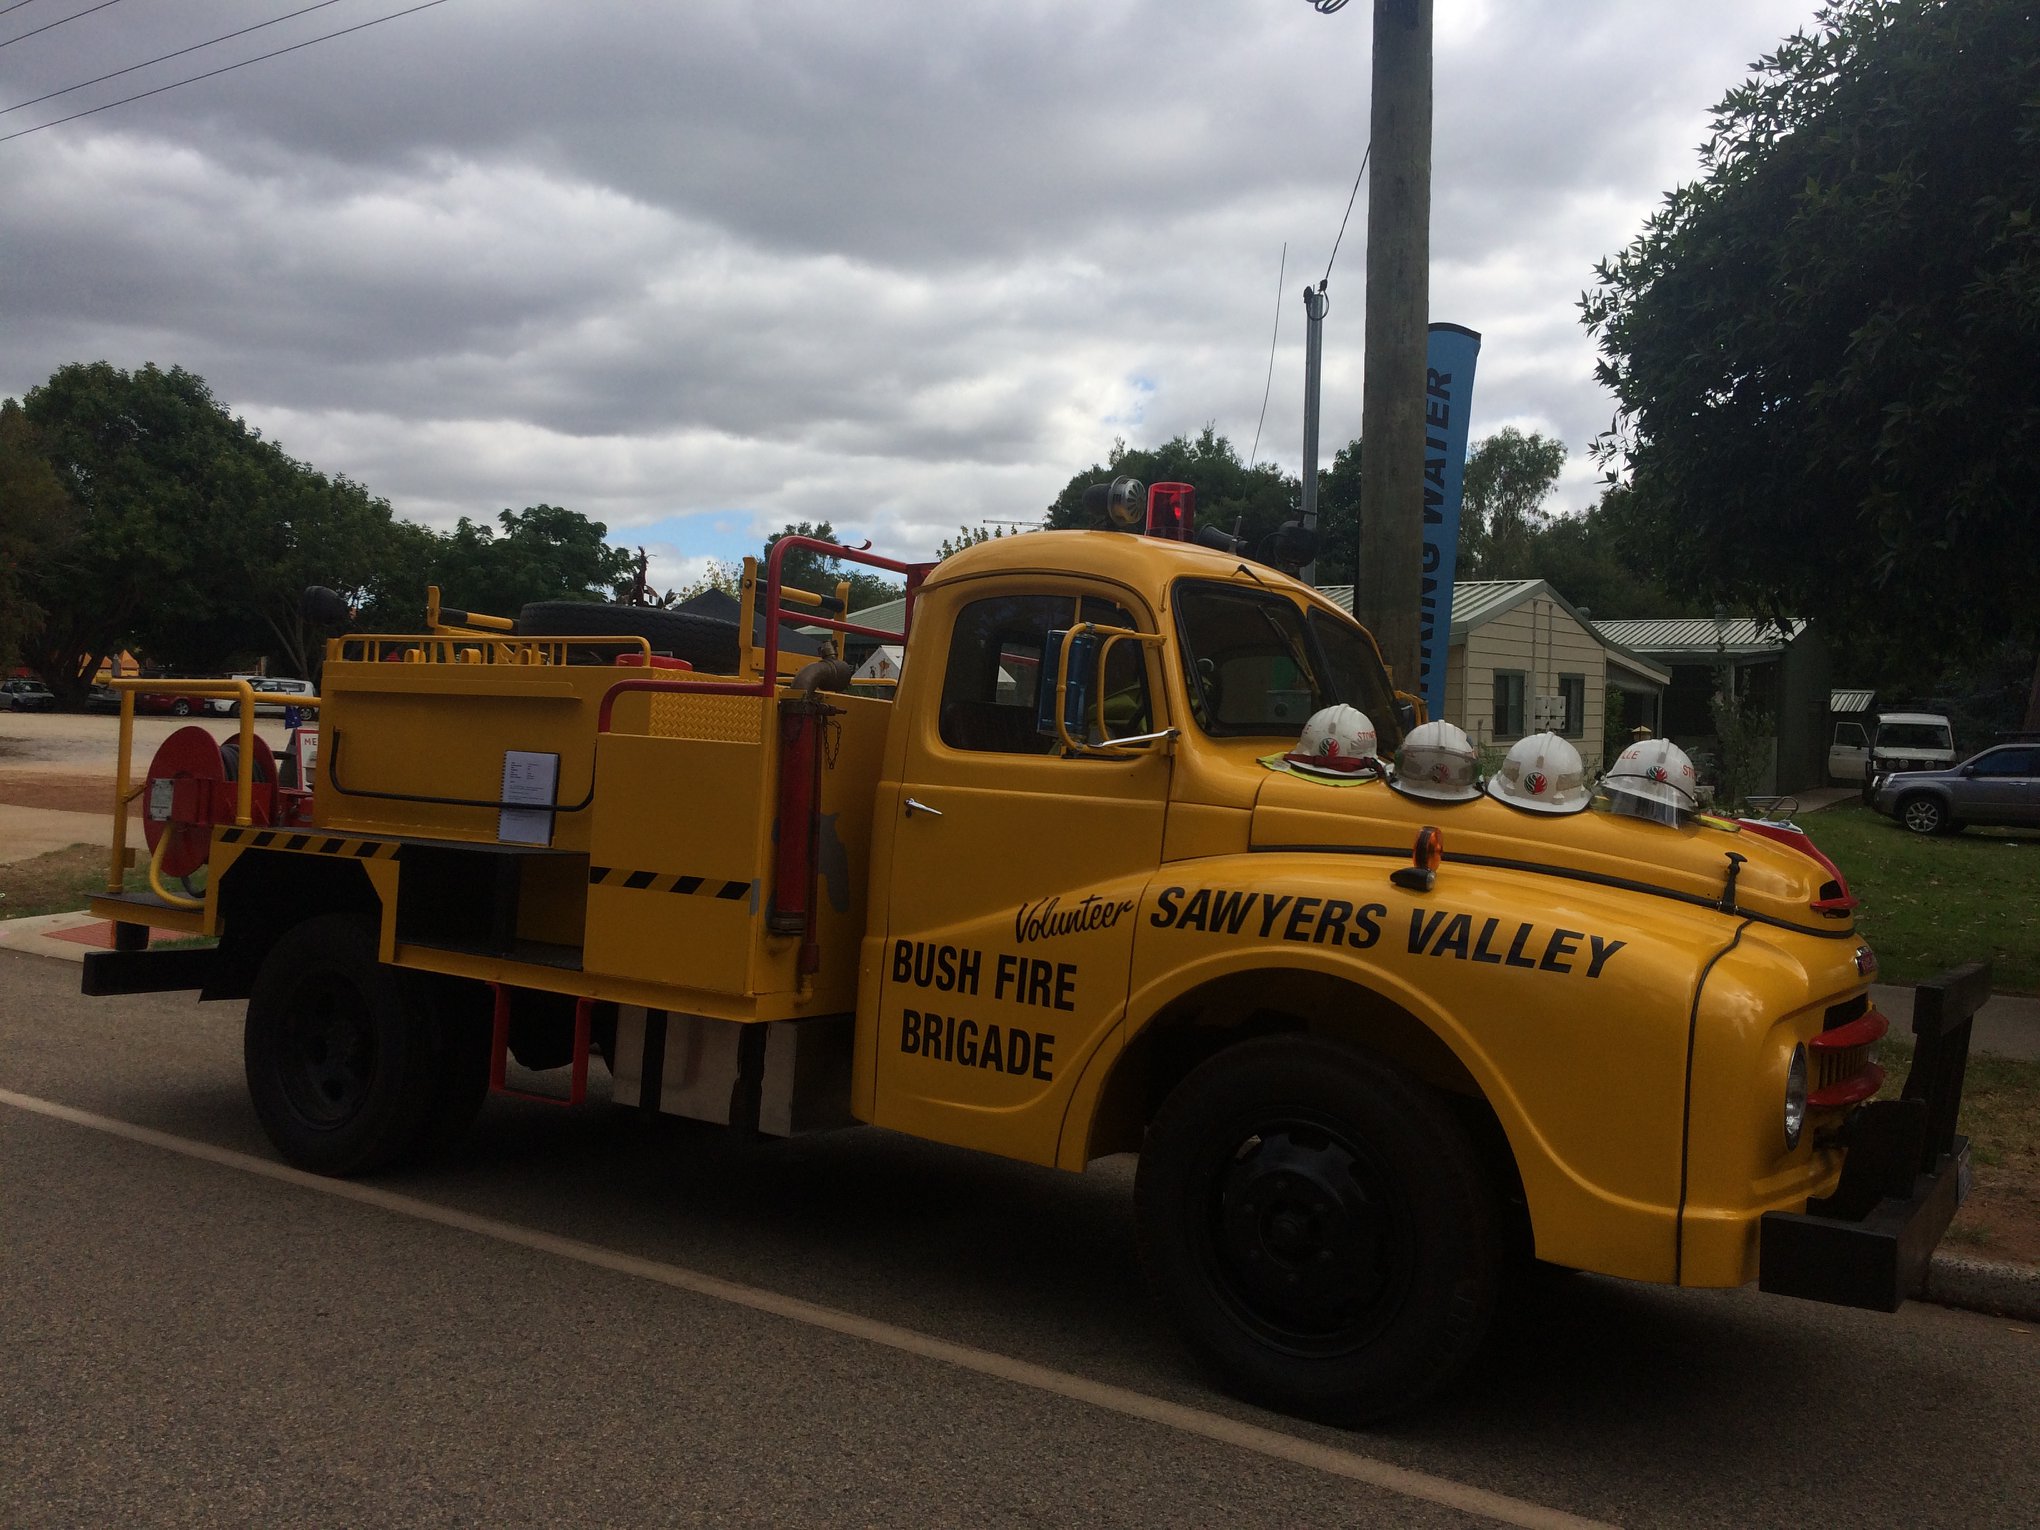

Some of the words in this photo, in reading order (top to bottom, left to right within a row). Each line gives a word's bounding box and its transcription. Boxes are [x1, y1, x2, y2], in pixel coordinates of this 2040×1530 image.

[1424, 367, 1451, 524] WATER
[1015, 894, 1134, 943] Volunteer
[1151, 887, 1386, 949] SAWYERS
[1407, 908, 1626, 978] VALLEY
[893, 939, 981, 996] BUSH
[995, 954, 1078, 1012] FIRE
[901, 1009, 1055, 1082] BRIGADE
